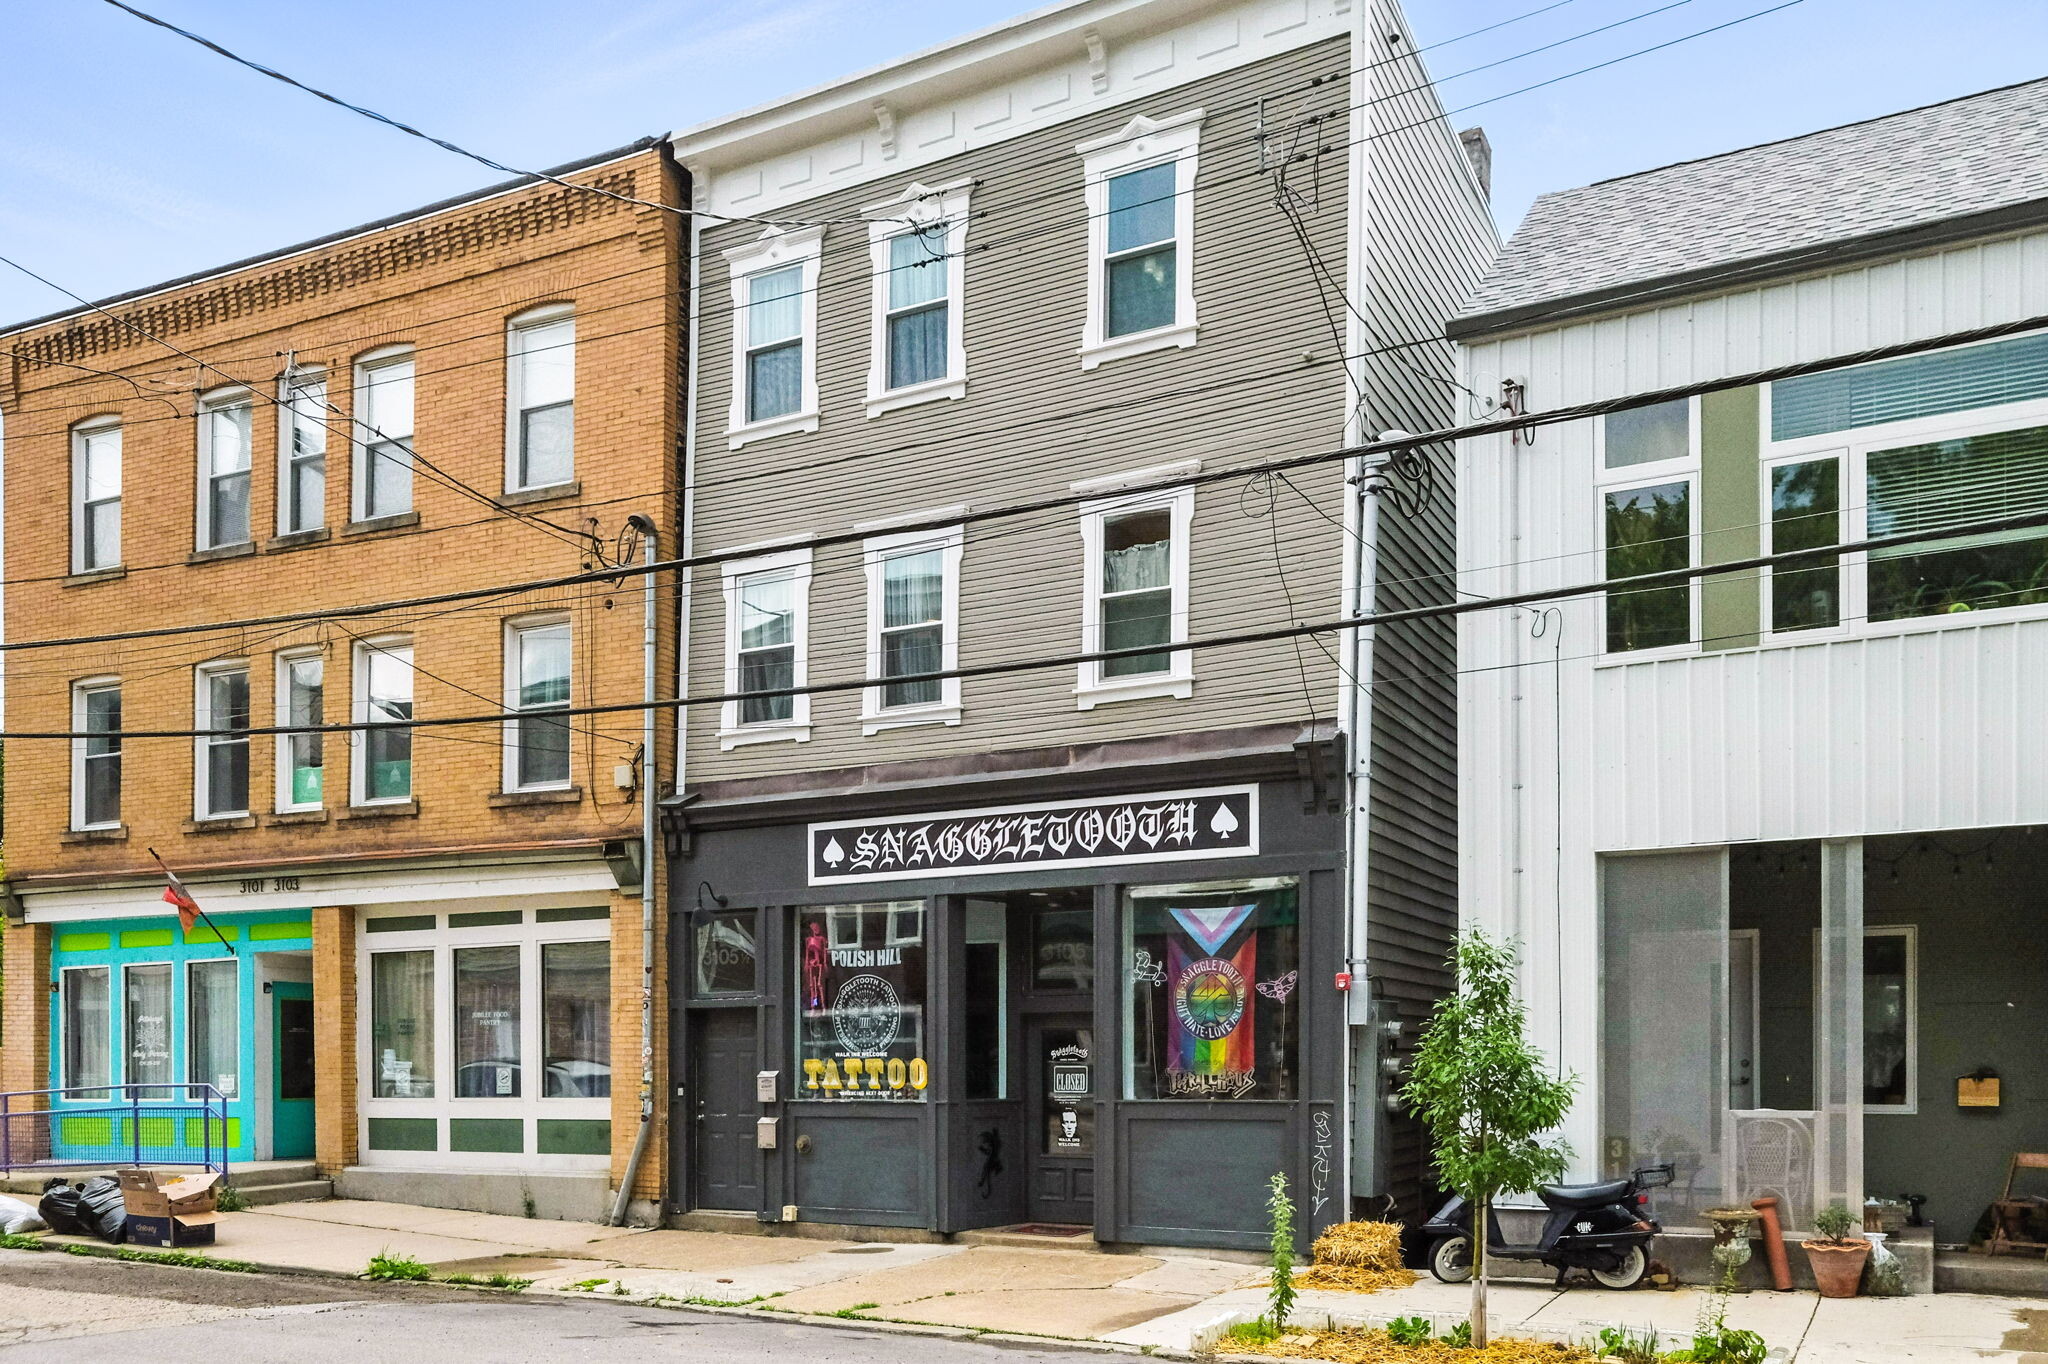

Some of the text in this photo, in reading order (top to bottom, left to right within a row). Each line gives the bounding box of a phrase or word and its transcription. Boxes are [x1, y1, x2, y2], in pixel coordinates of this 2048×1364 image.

[850, 800, 1198, 872] SNAGGLETOOTH
[240, 879, 299, 893] 3101 3103
[831, 948, 901, 967] POLISH HILL
[1181, 960, 1244, 986] SNAGGLETOOTH
[837, 977, 897, 1009] SNAGGLETOOTH TATTOO
[1208, 1022, 1233, 1039] LOVE
[803, 1058, 928, 1090] TATTOO
[1056, 1073, 1086, 1091] CLOSED
[136, 1224, 157, 1234] chewy
